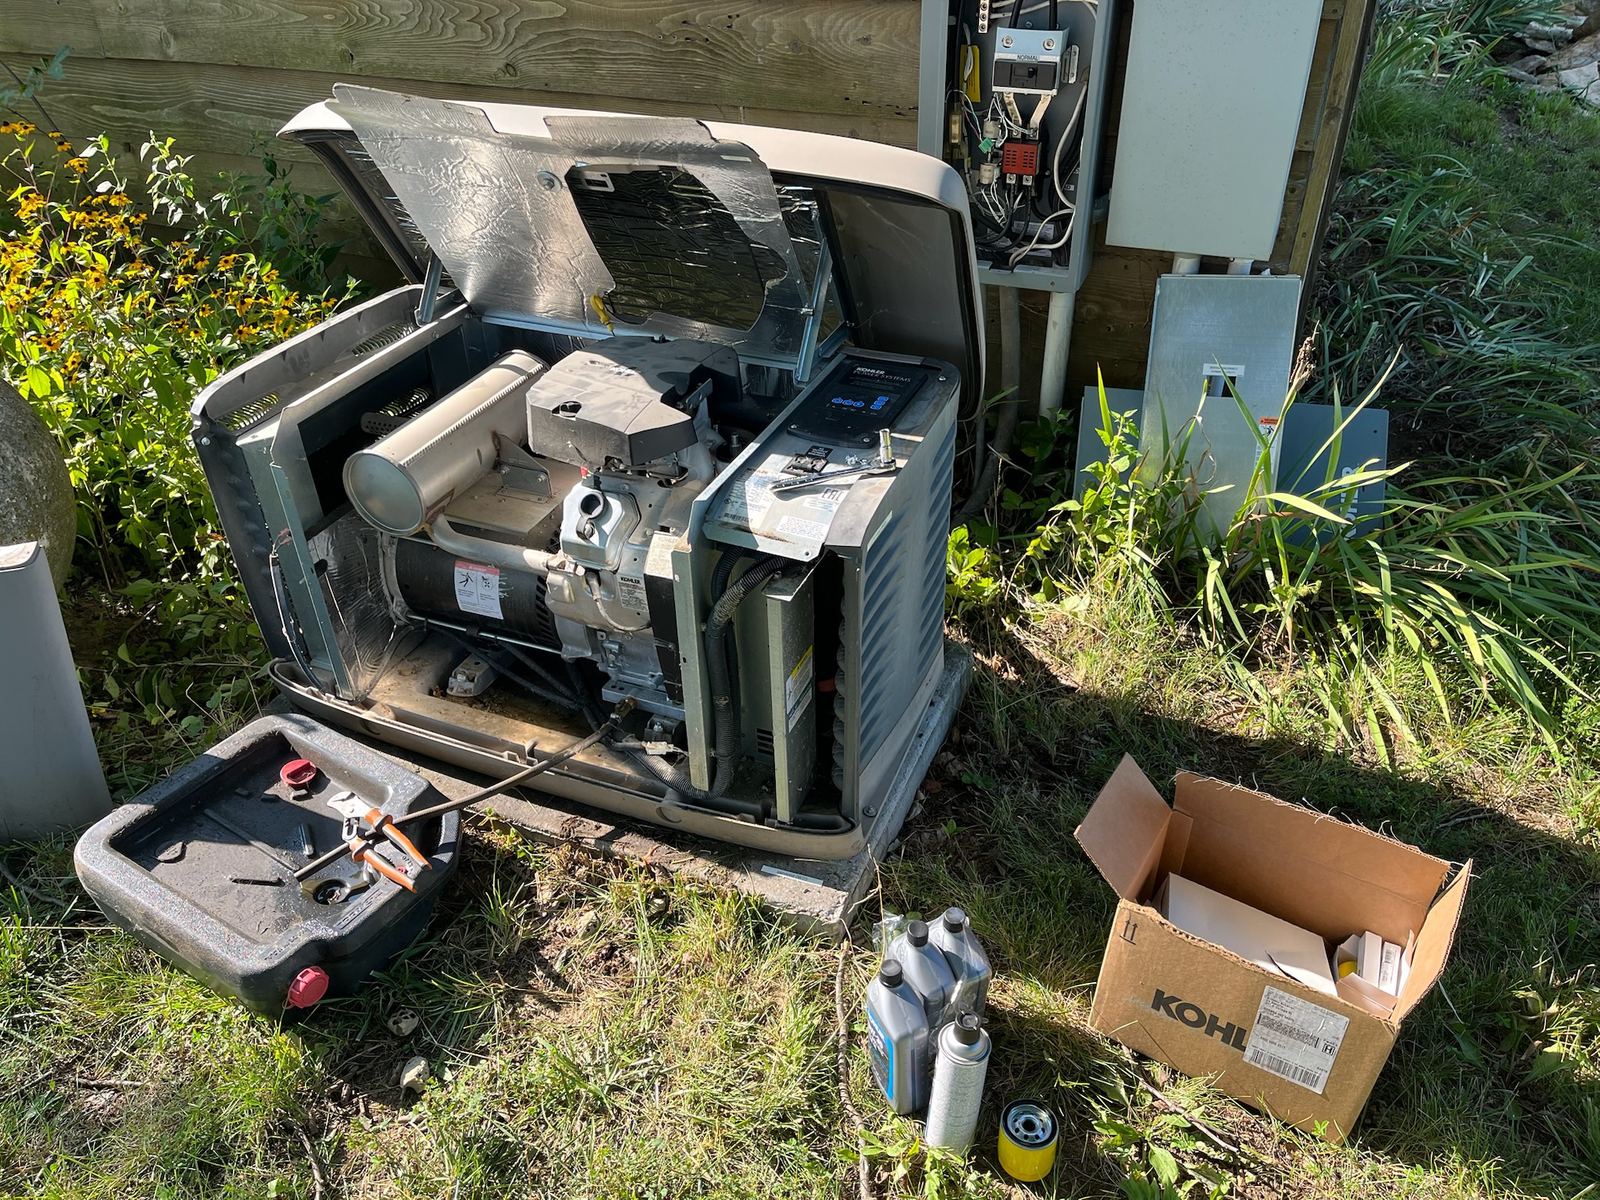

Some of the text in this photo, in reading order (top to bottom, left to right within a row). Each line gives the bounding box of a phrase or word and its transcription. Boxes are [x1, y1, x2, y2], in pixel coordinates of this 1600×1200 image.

[853, 370, 912, 383] POWER SYSTEMS
[856, 367, 885, 375] KOHLER
[1151, 988, 1247, 1052] KOHL
